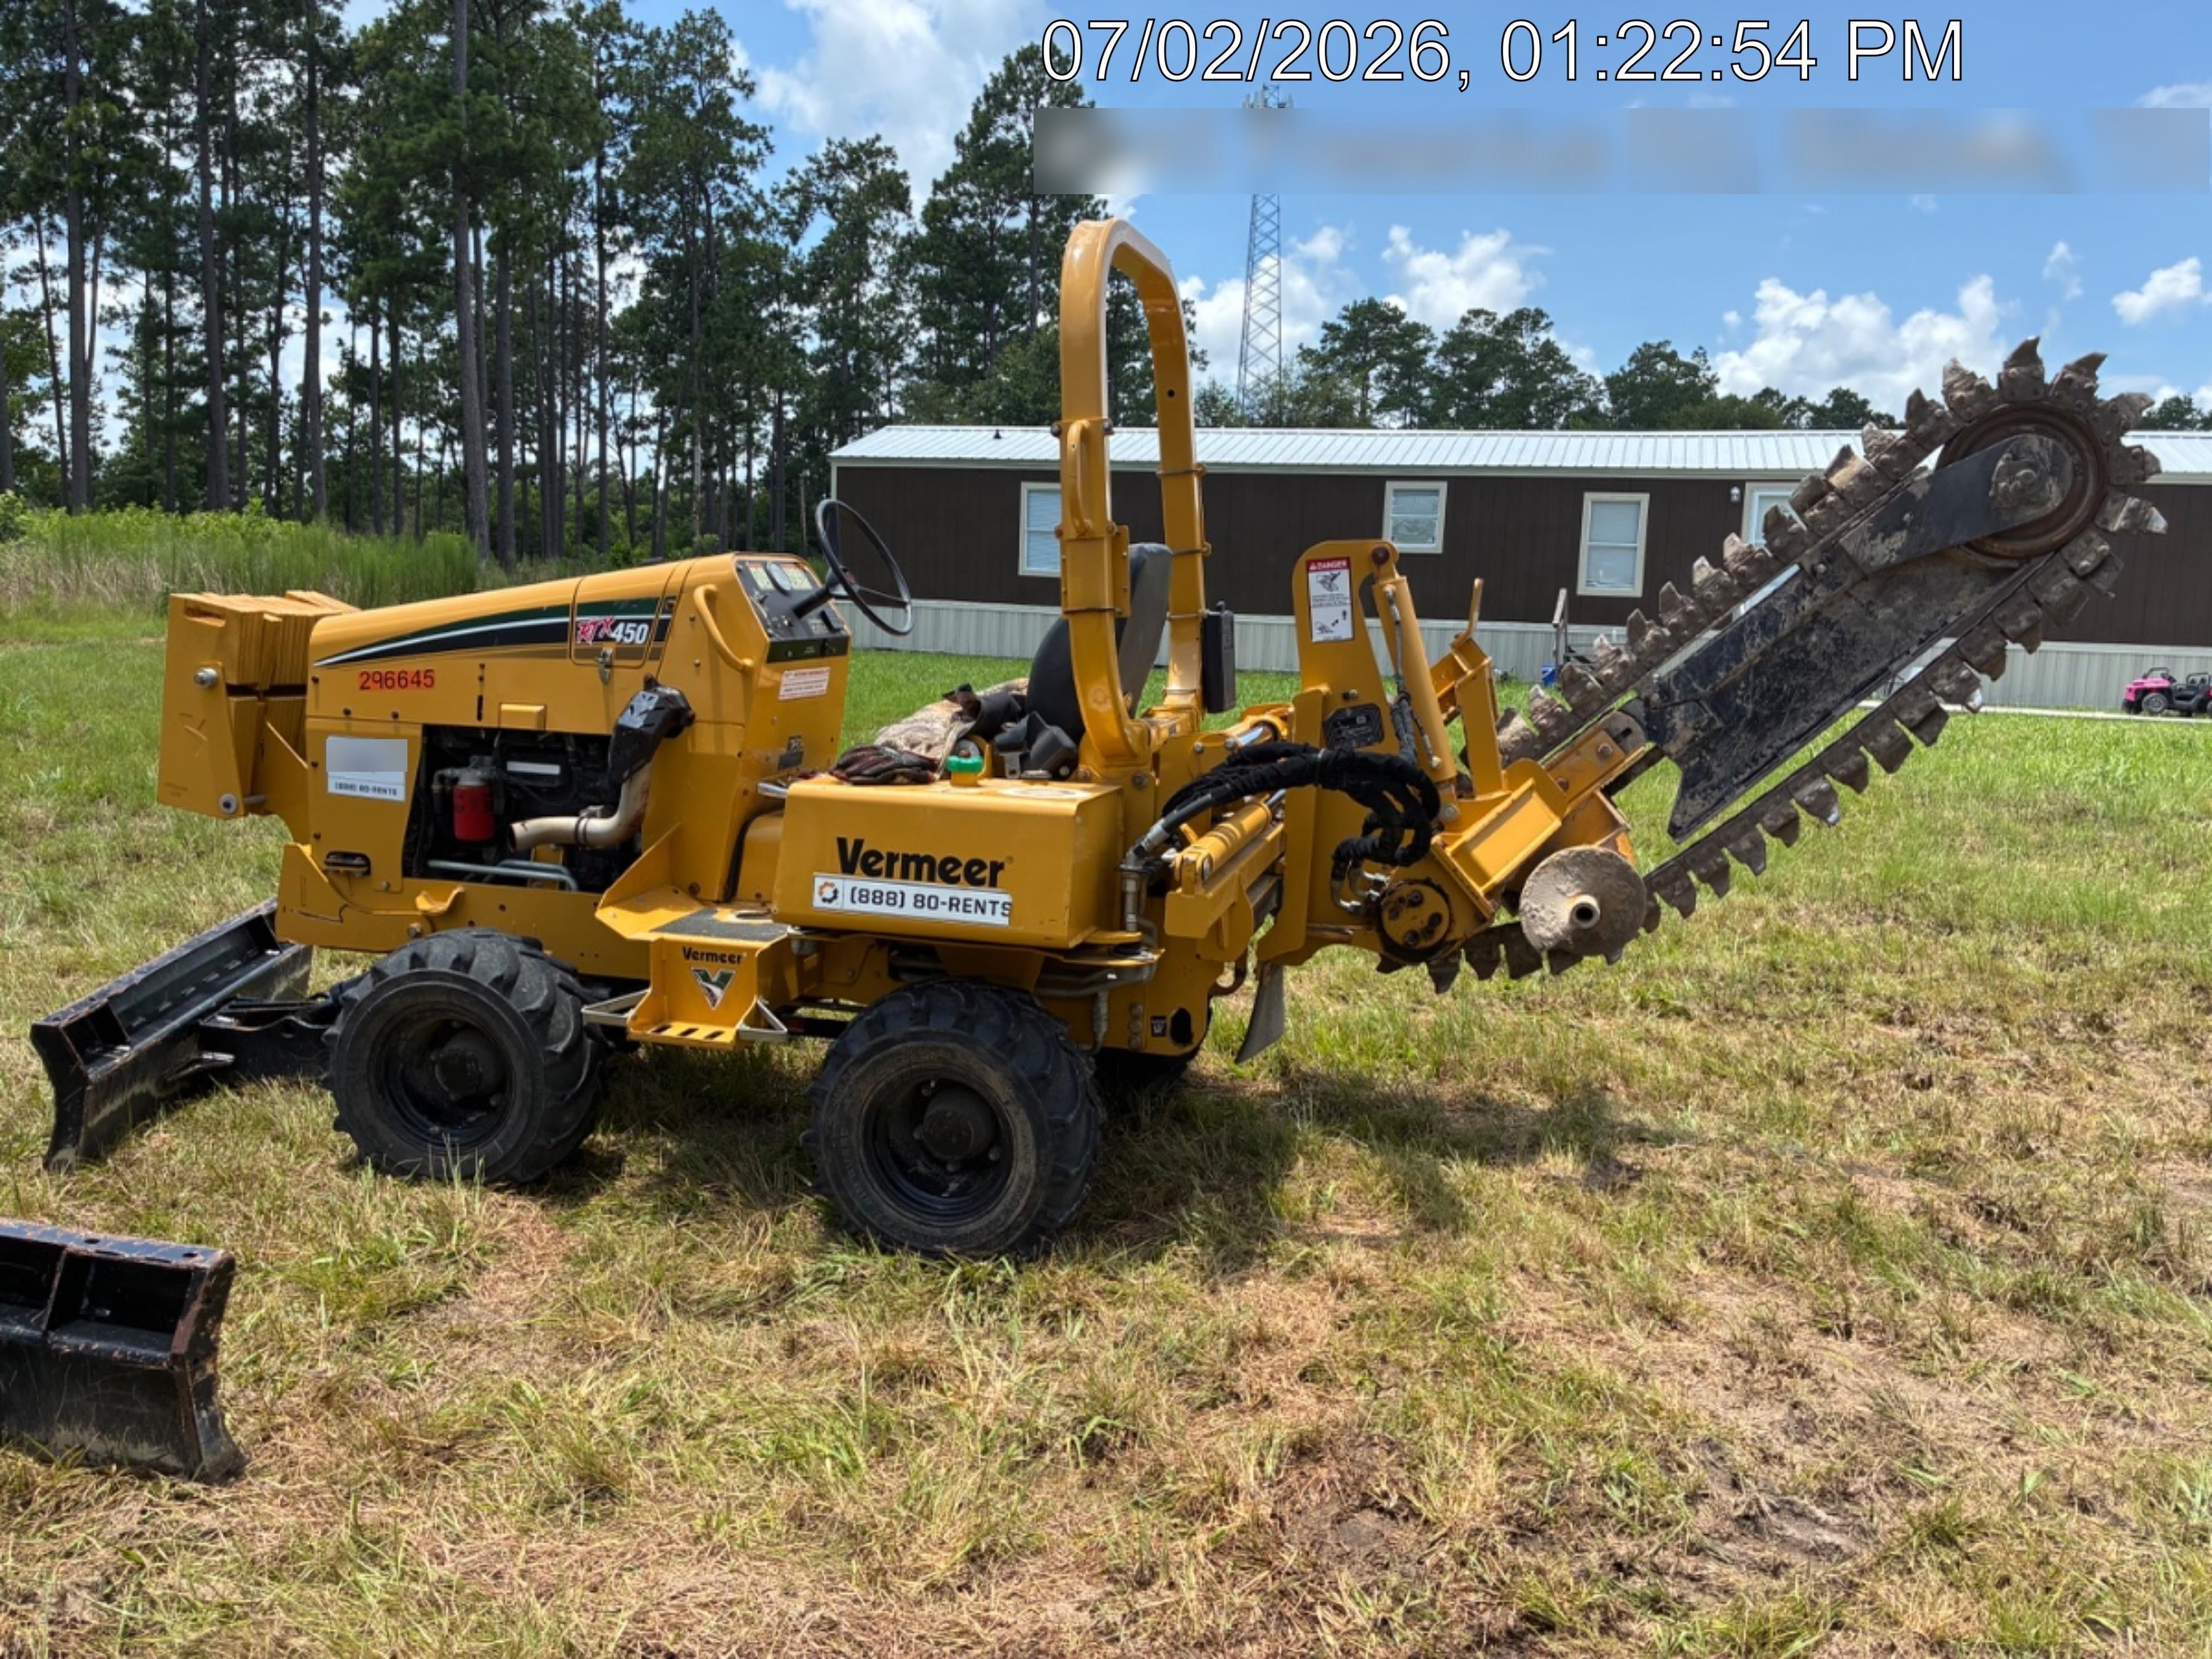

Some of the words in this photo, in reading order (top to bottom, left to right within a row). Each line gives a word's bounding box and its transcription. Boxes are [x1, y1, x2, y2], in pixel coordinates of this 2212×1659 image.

[359, 669, 434, 690] 296645
[836, 836, 1005, 887] Vermeer
[850, 886, 905, 909] (888)
[913, 893, 1011, 917] 80-RENTS
[682, 946, 743, 965] Vermeer
